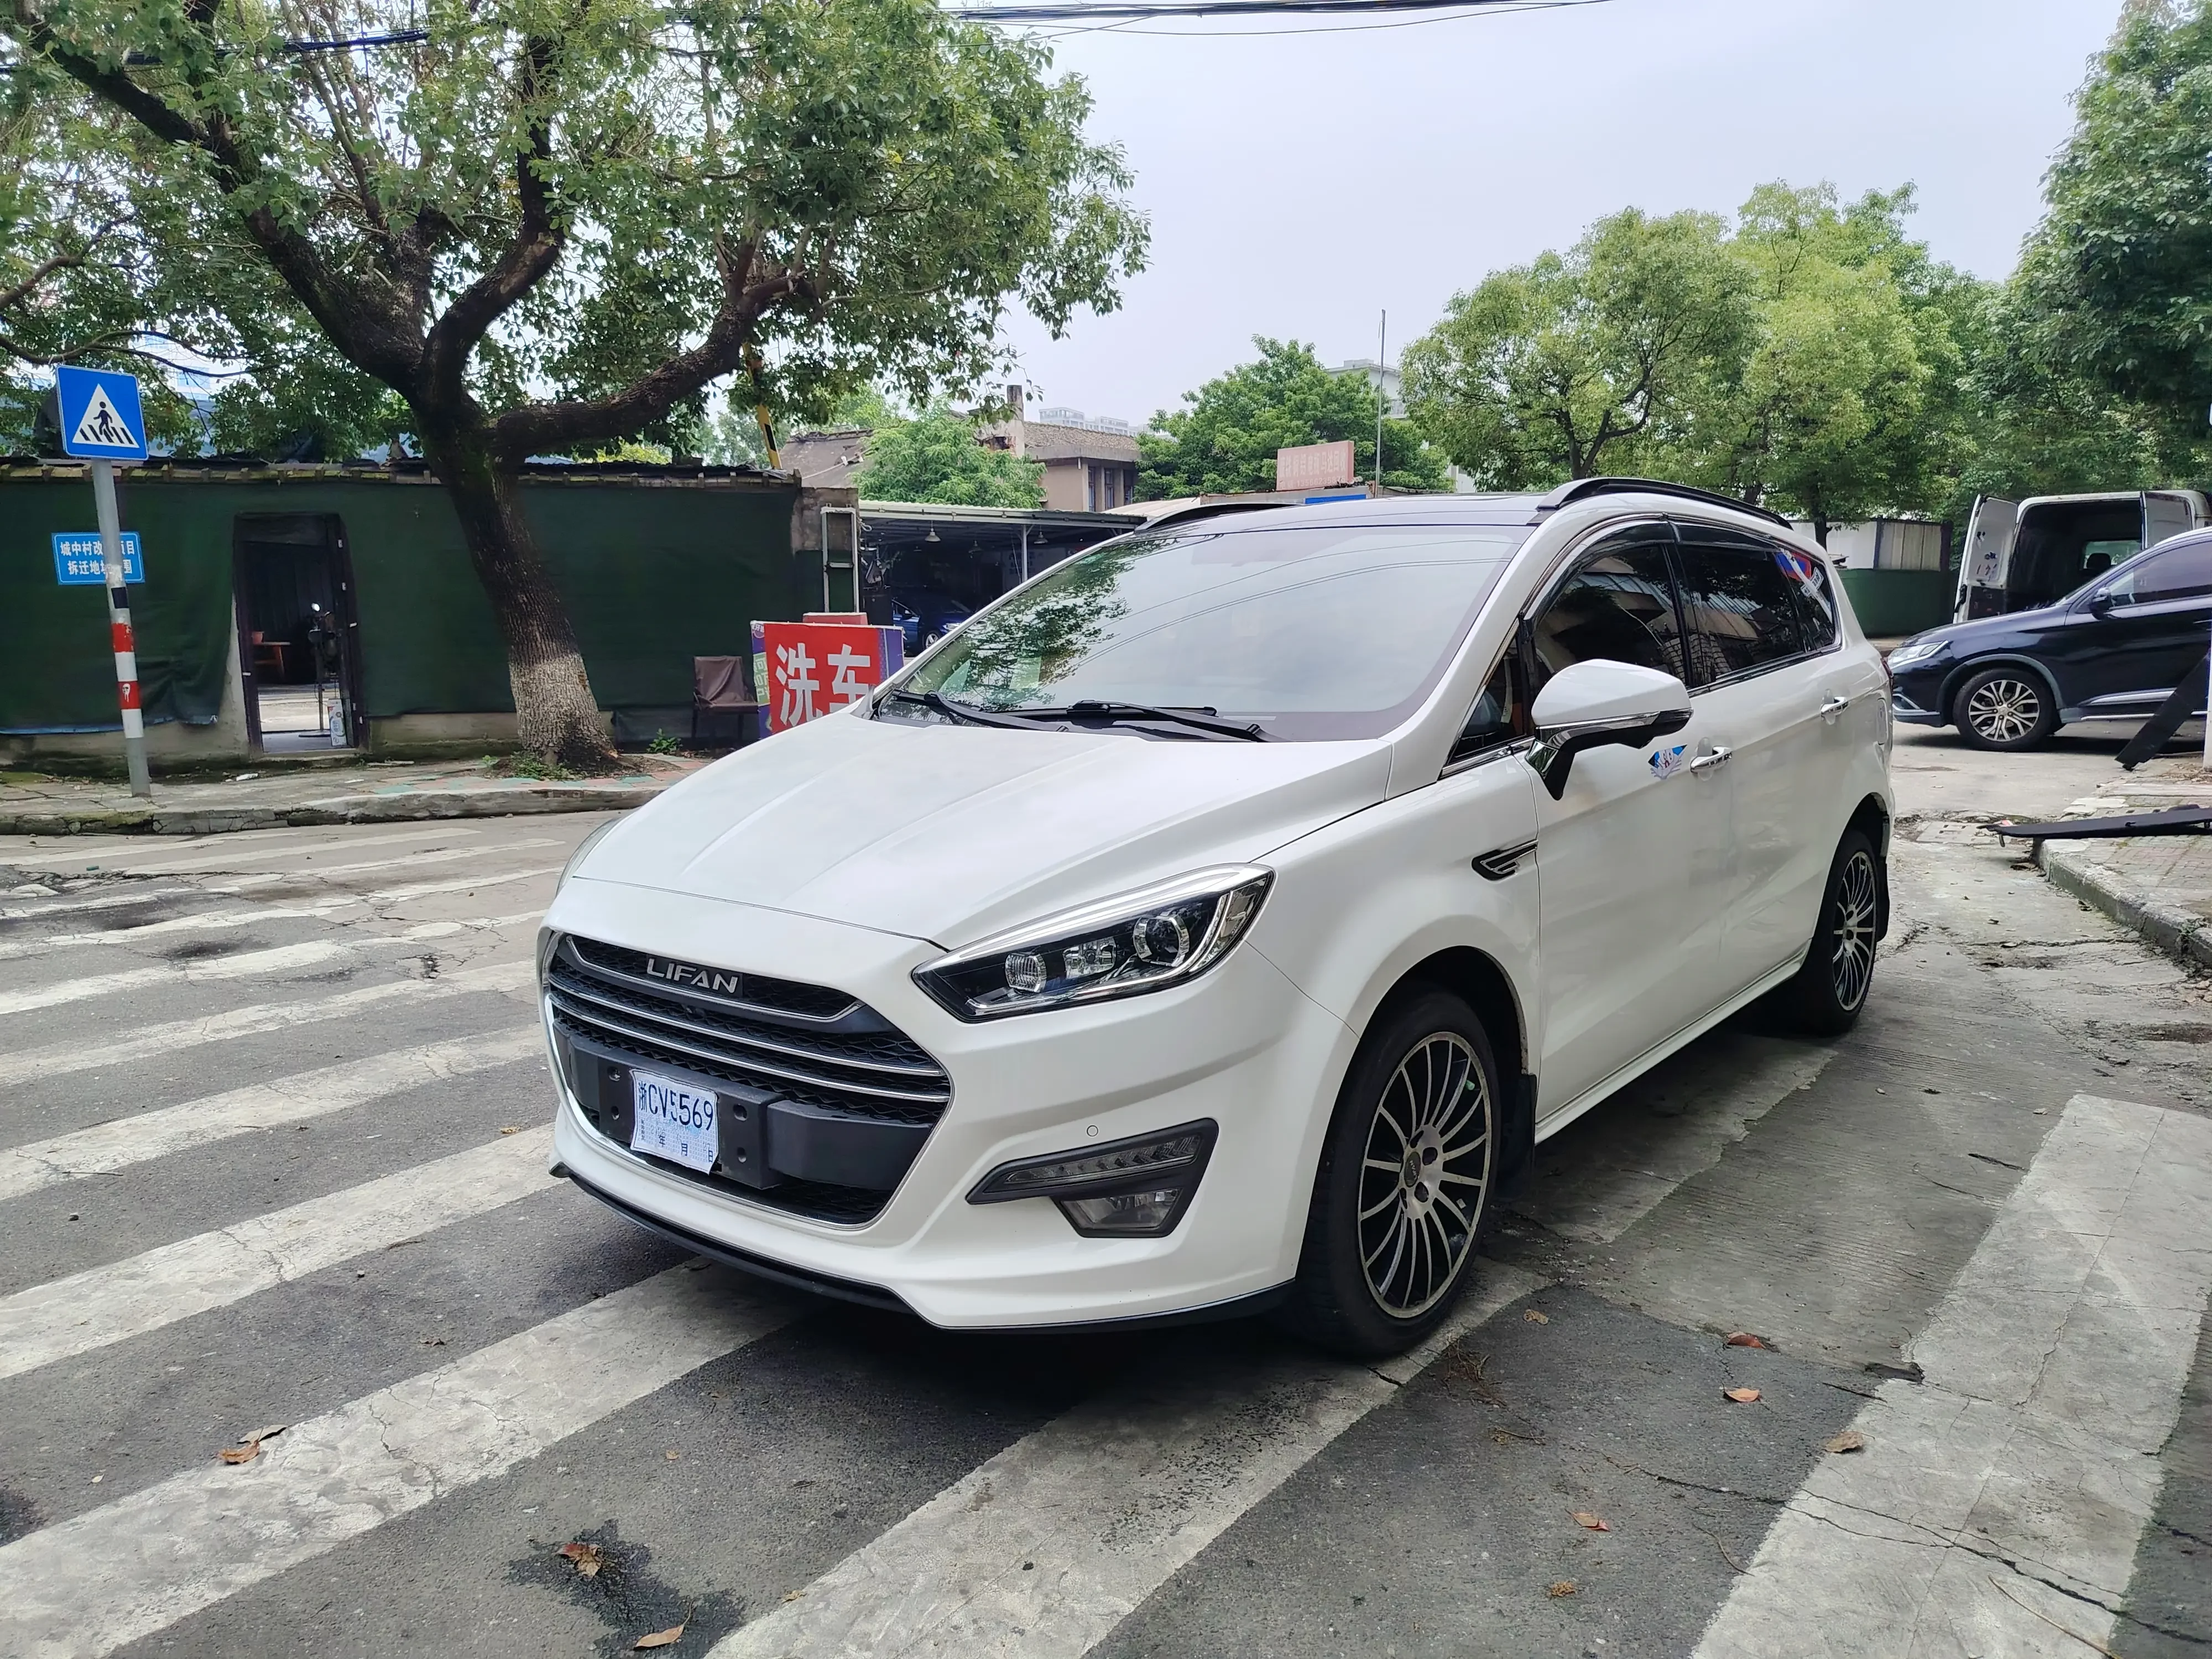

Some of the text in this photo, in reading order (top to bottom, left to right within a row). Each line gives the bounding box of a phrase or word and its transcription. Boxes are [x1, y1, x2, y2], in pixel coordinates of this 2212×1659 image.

[775, 642, 870, 727] 洗车
[646, 958, 738, 993] LIFAN
[681, 1142, 688, 1156] 月
[708, 1150, 713, 1163] 日
